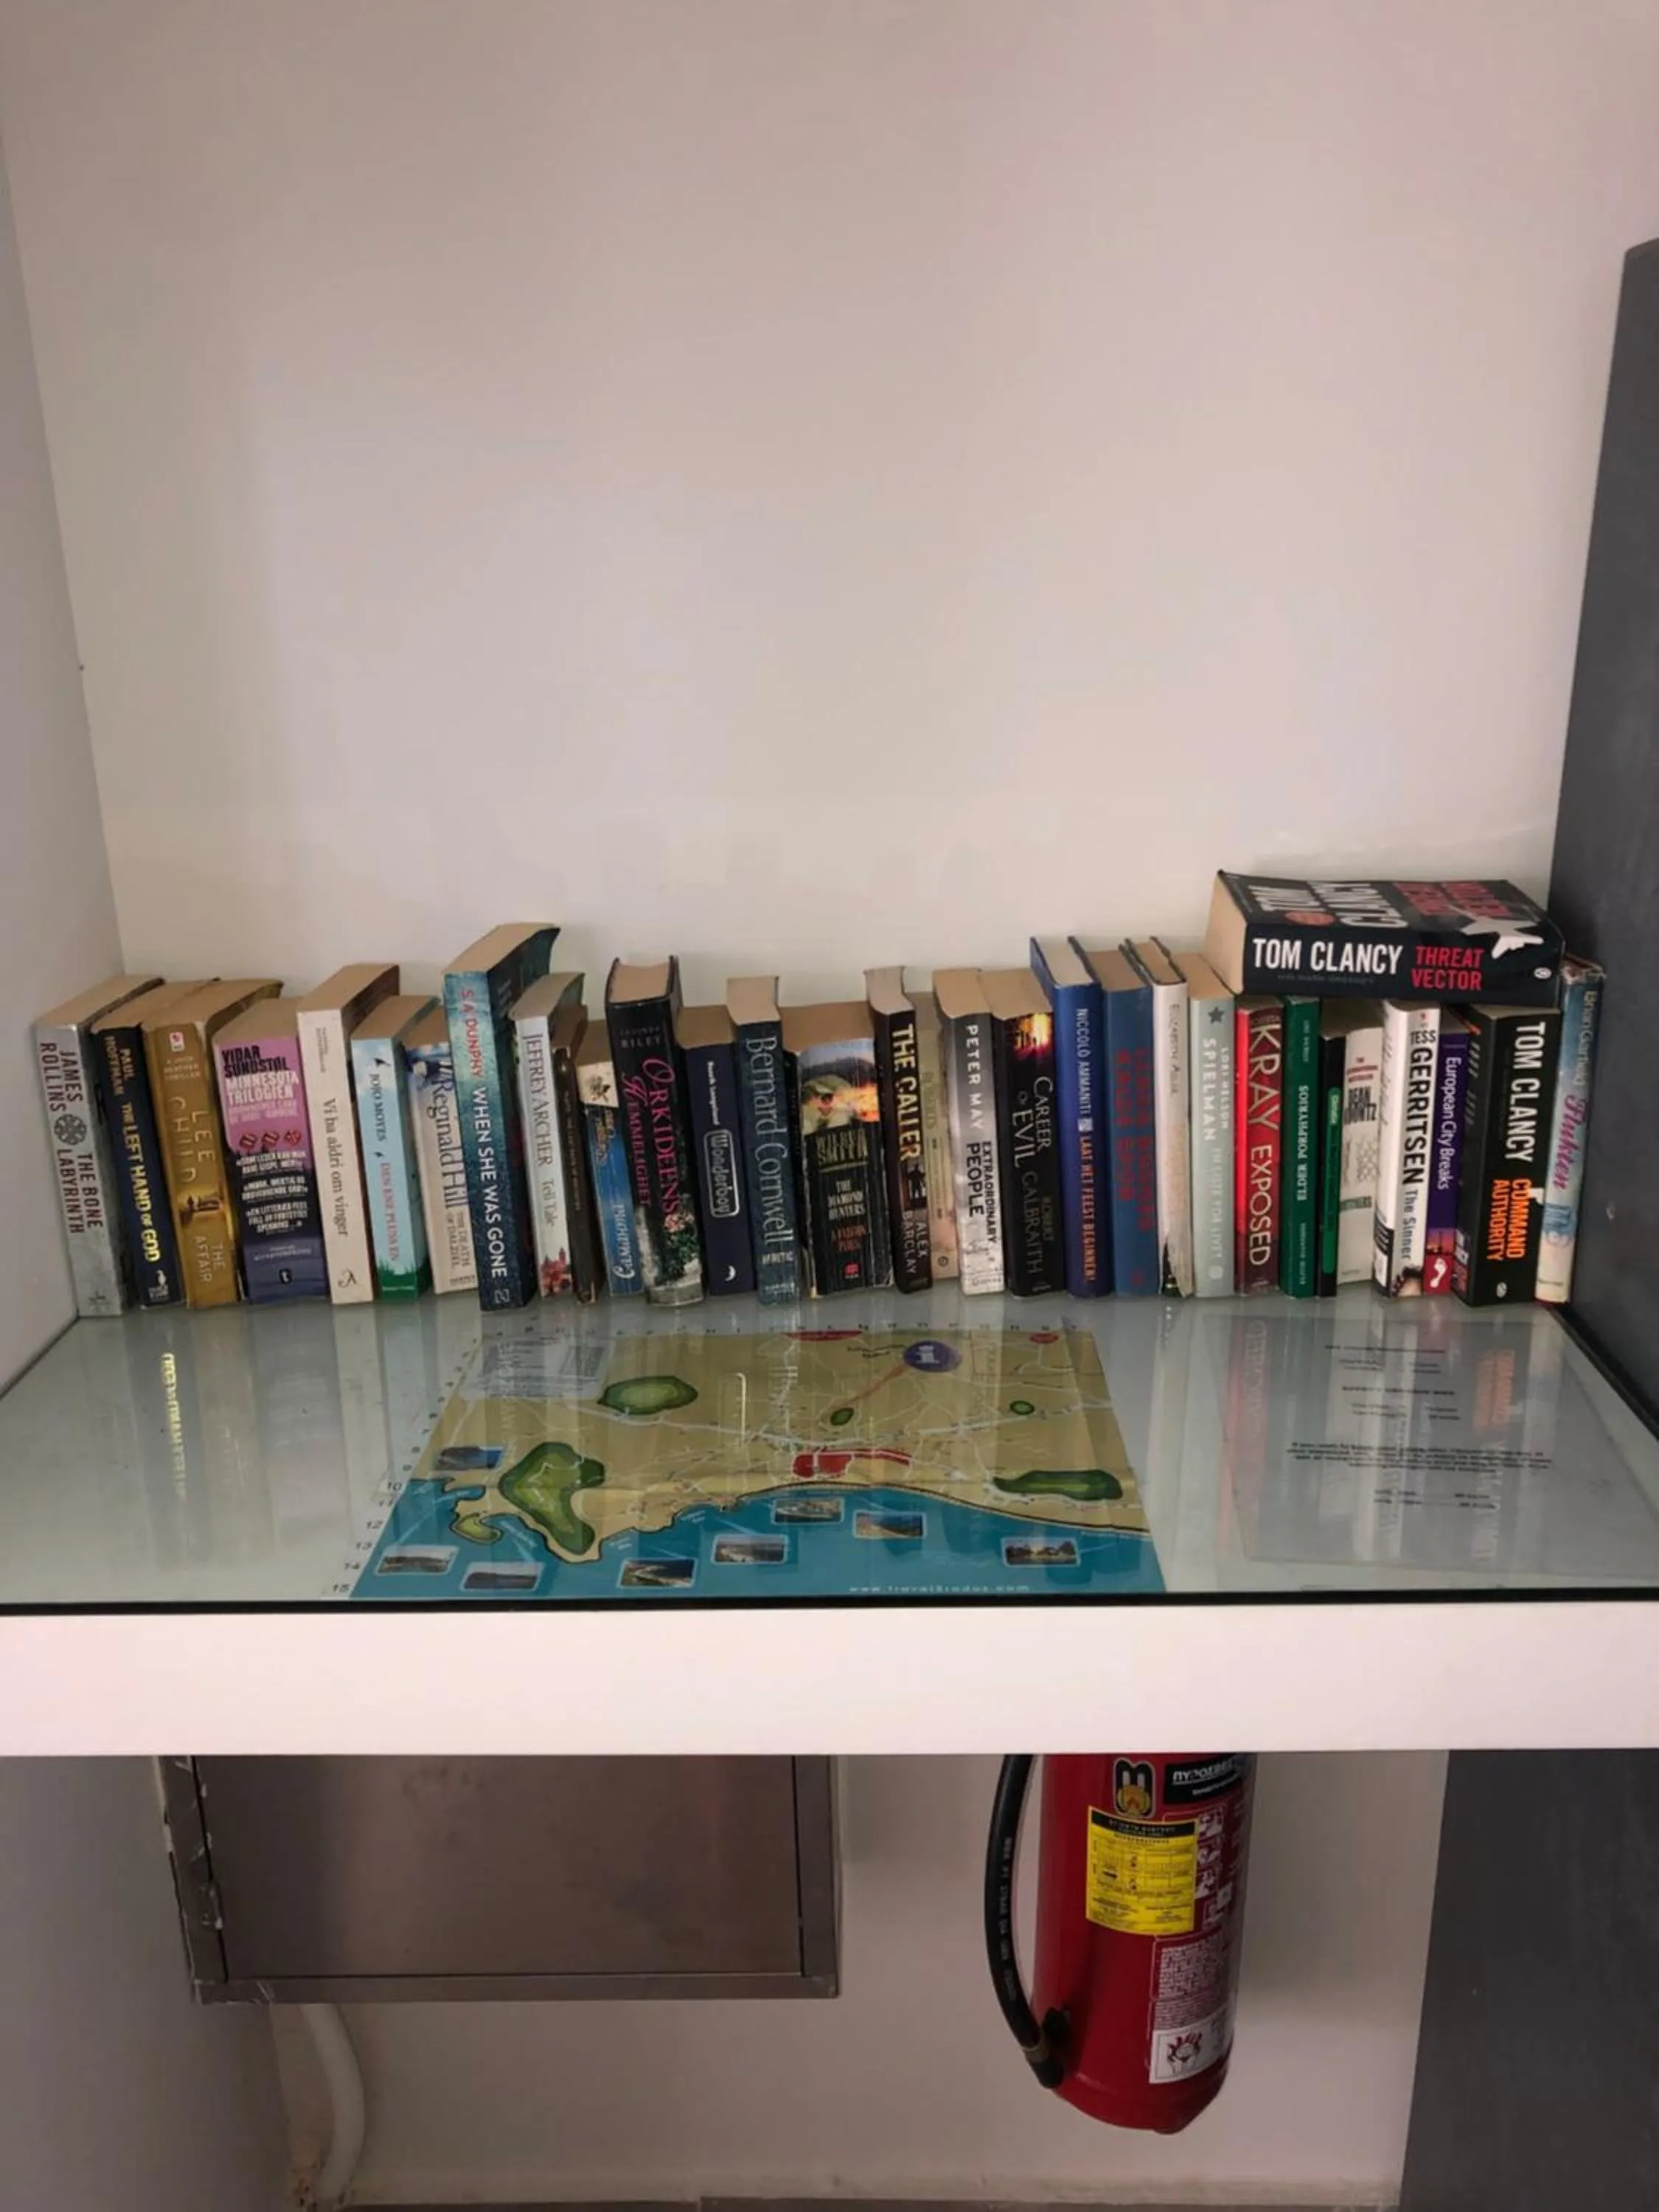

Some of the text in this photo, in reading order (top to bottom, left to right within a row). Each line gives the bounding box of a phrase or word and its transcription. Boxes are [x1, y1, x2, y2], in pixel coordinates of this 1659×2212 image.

[1253, 937, 1403, 975] TOM CLANCY
[1411, 967, 1482, 991] VECTOR
[1416, 945, 1484, 969] THREAT
[104, 1035, 125, 1096] HOFFMAN
[119, 1048, 135, 1082] PAUL
[222, 1046, 260, 1063] VIDAR
[465, 1019, 485, 1078] DUNPHY
[1411, 1030, 1437, 1045] TESS
[1572, 1029, 1593, 1087] Garfield
[40, 1042, 66, 1112] ROLLINS
[61, 1050, 83, 1102] JAMES
[225, 1070, 299, 1089] MINNESOTA
[227, 1085, 293, 1107] TRILOGIEN
[323, 1098, 337, 1114] Vi
[369, 1074, 387, 1141] JOJO MOYES
[522, 1034, 554, 1166] JEFFREY ARCHER
[745, 1036, 787, 1135] Bernard
[891, 1023, 922, 1161] THE CALLER
[965, 1023, 984, 1130] PETER MAY
[1078, 1061, 1092, 1115] AMMANITI
[1203, 1037, 1217, 1141] SPIELMAN
[1248, 1023, 1281, 1131] KRAY
[1505, 1021, 1545, 1163] TOM CLANCY
[124, 1124, 144, 1162] LEFT
[192, 1110, 215, 1162] LEE
[425, 1079, 468, 1209] Reginald Hill
[622, 1073, 652, 1208] HEMMELIGHET
[642, 1058, 681, 1214] ORKIDEENS
[1012, 1107, 1036, 1168] EVIL
[1034, 1075, 1054, 1153] CAREER
[1297, 1085, 1310, 1201] ELDER PORPHYRIOS
[1402, 1046, 1433, 1186] GERRITSEN
[1437, 1056, 1461, 1190] European City Breaks
[1552, 1093, 1587, 1190] Flukten
[327, 1136, 343, 1168] aldri
[331, 1171, 344, 1193] om
[472, 1086, 508, 1279] WHEN SHE WAS GONE
[710, 1133, 733, 1214] Wonderboy
[966, 1143, 985, 1219] PEOPLE
[1081, 1164, 1094, 1184] HET
[57, 1148, 86, 1234] LABYRINTH
[77, 1153, 103, 1228] THE BONE
[129, 1165, 152, 1211] HAND
[333, 1196, 349, 1237] vinger
[541, 1178, 557, 1201] Tell
[754, 1143, 795, 1245] Cornwell
[979, 1141, 998, 1245] EXTRAORDINARY
[1082, 1187, 1095, 1220] FEEST
[1249, 1144, 1272, 1266] EXPOSED
[1506, 1178, 1531, 1259] COMMAND
[141, 1228, 161, 1262] GOD
[458, 1228, 471, 1267] DEATH
[902, 1210, 917, 1274] BARCLAY
[915, 1222, 929, 1258] ALEX
[1020, 1170, 1043, 1274] GALBRAITH
[1401, 1189, 1418, 1259] The Sinner
[1486, 1179, 1511, 1262] AUTHORITY
[194, 1236, 212, 1283] AFFAIR
[212, 1244, 225, 1270] THE
